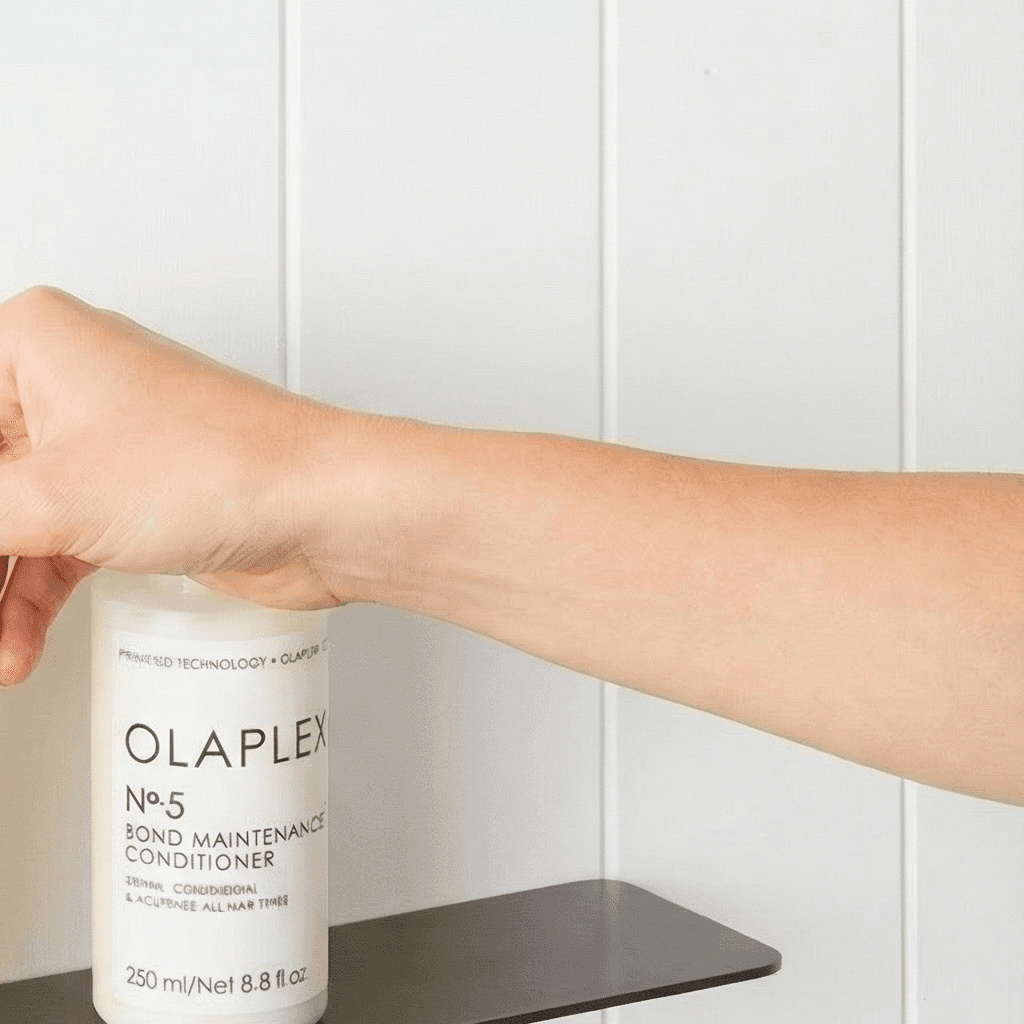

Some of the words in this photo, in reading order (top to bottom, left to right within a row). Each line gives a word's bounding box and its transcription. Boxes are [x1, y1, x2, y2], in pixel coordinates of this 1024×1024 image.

[178, 656, 267, 671] TECHNOLOGY
[125, 709, 326, 768] OLAPLEX
[126, 823, 183, 847] BOND
[125, 845, 275, 871] CONDITIONER
[126, 965, 158, 990] 250
[241, 971, 271, 994] 8.8
